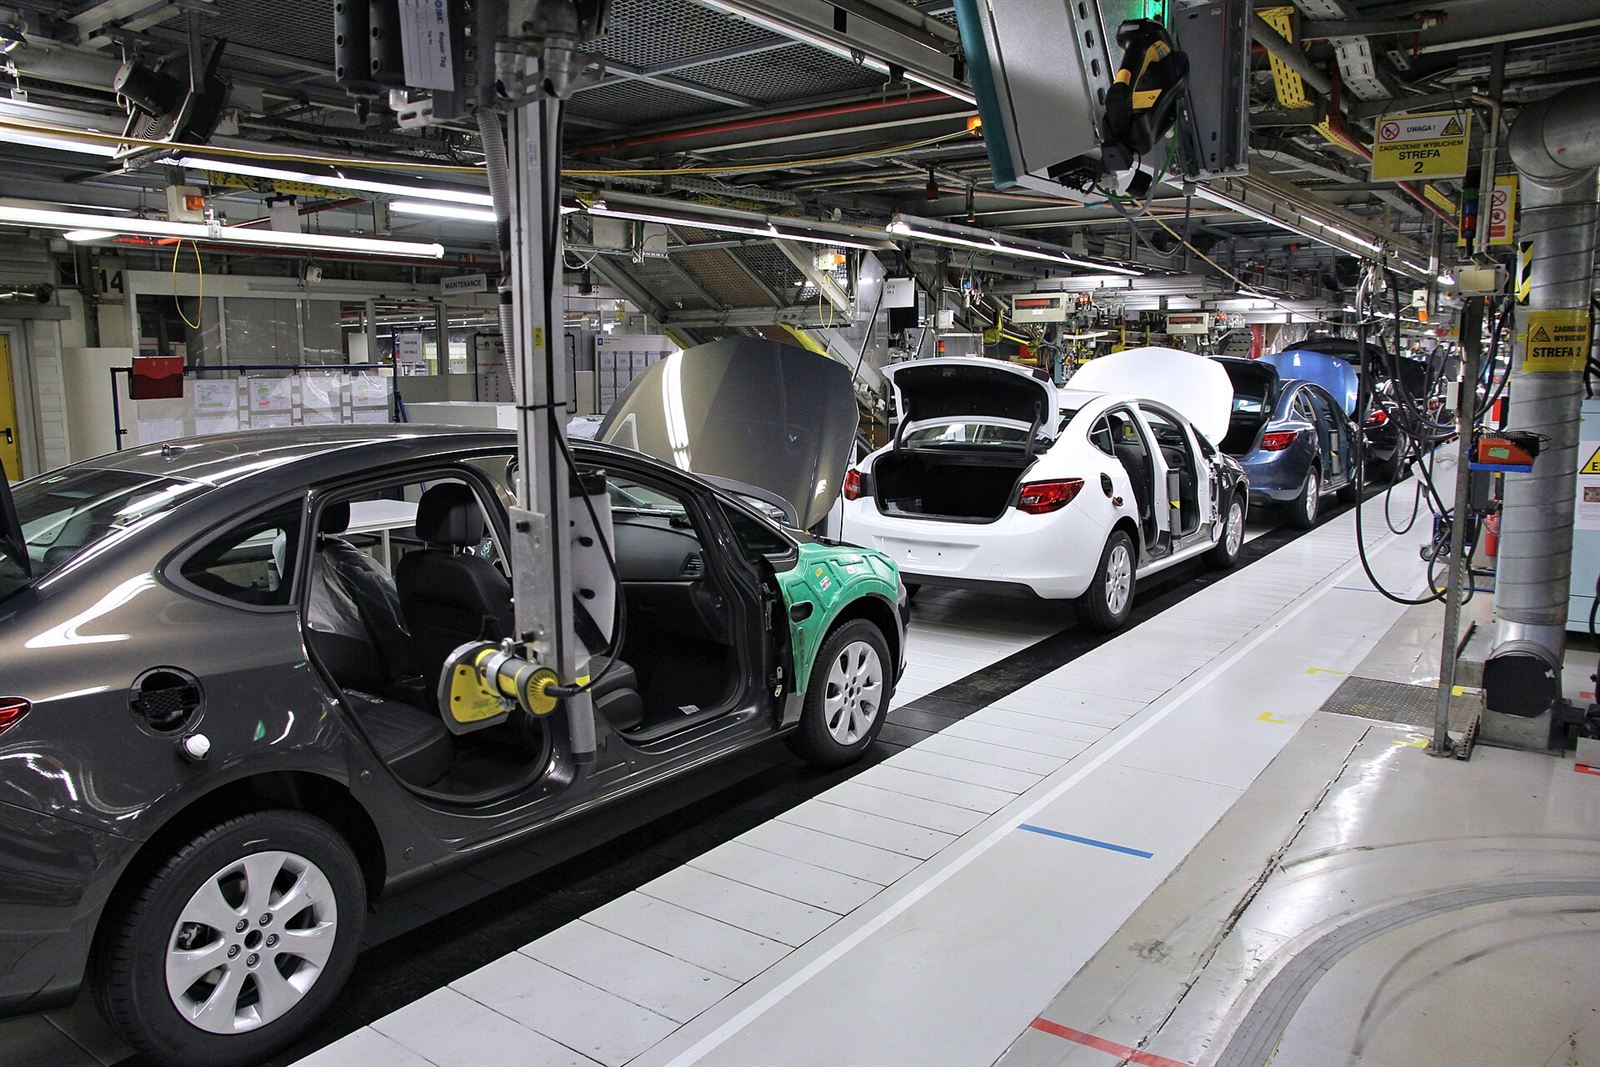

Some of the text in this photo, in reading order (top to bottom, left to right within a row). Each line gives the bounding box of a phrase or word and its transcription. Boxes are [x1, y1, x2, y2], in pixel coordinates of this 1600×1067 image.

[1407, 125, 1433, 133] UWAGA
[1423, 139, 1464, 149] WYBUCHEM
[1398, 149, 1441, 160] STREFA
[1413, 161, 1424, 174] 2
[99, 269, 124, 294] 14
[444, 279, 483, 289] MAINTENANCE
[1532, 345, 1582, 358] STREFA 2
